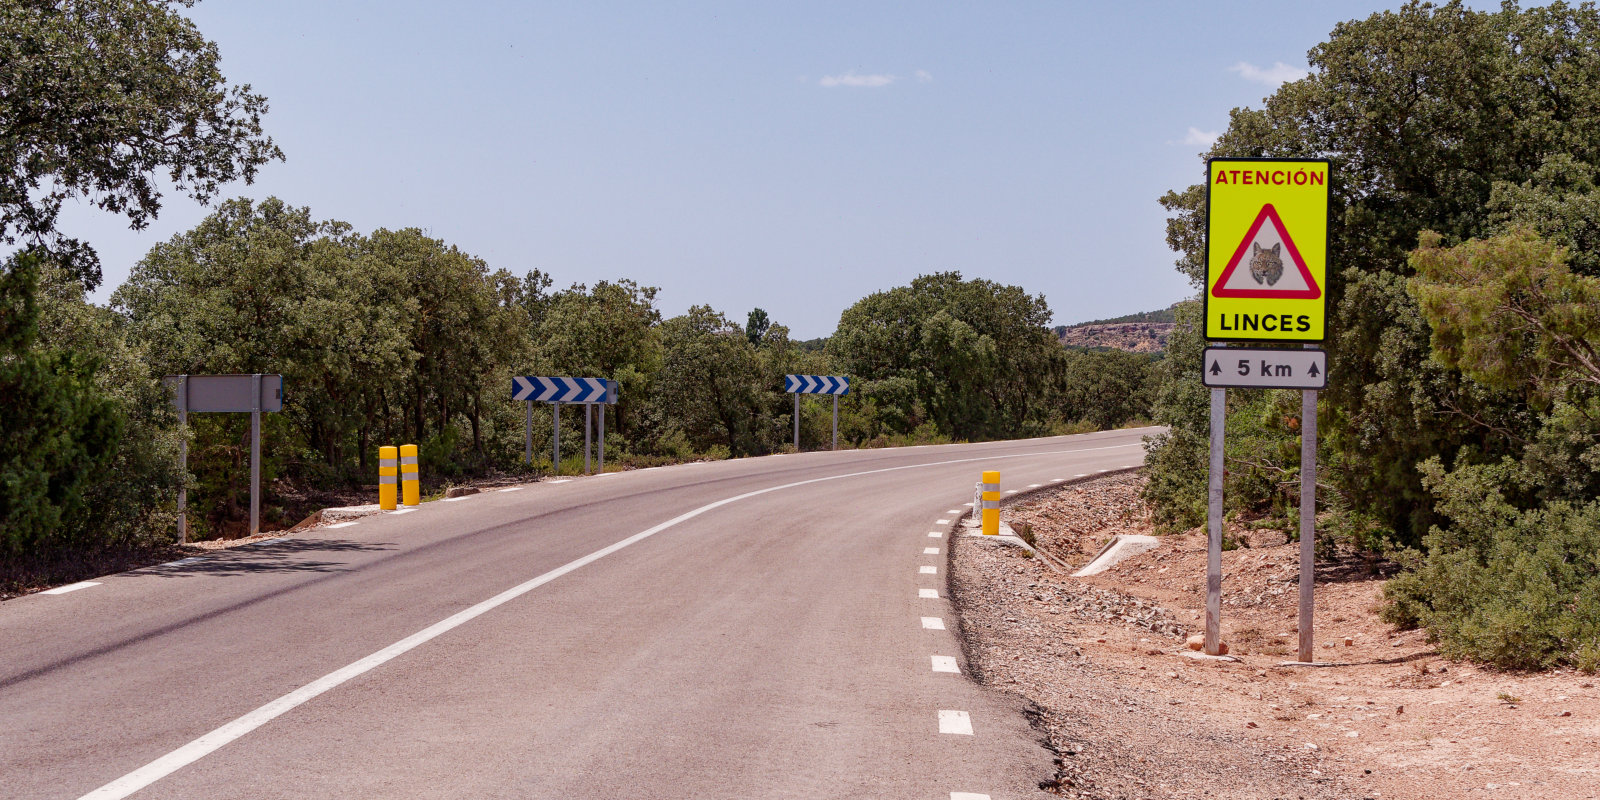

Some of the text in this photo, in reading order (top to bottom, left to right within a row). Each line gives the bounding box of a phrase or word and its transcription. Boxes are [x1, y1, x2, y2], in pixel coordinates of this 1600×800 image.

[1215, 168, 1324, 186] ATENCIÓN
[1220, 313, 1311, 332] LINCES
[1237, 359, 1292, 377] 5 km
